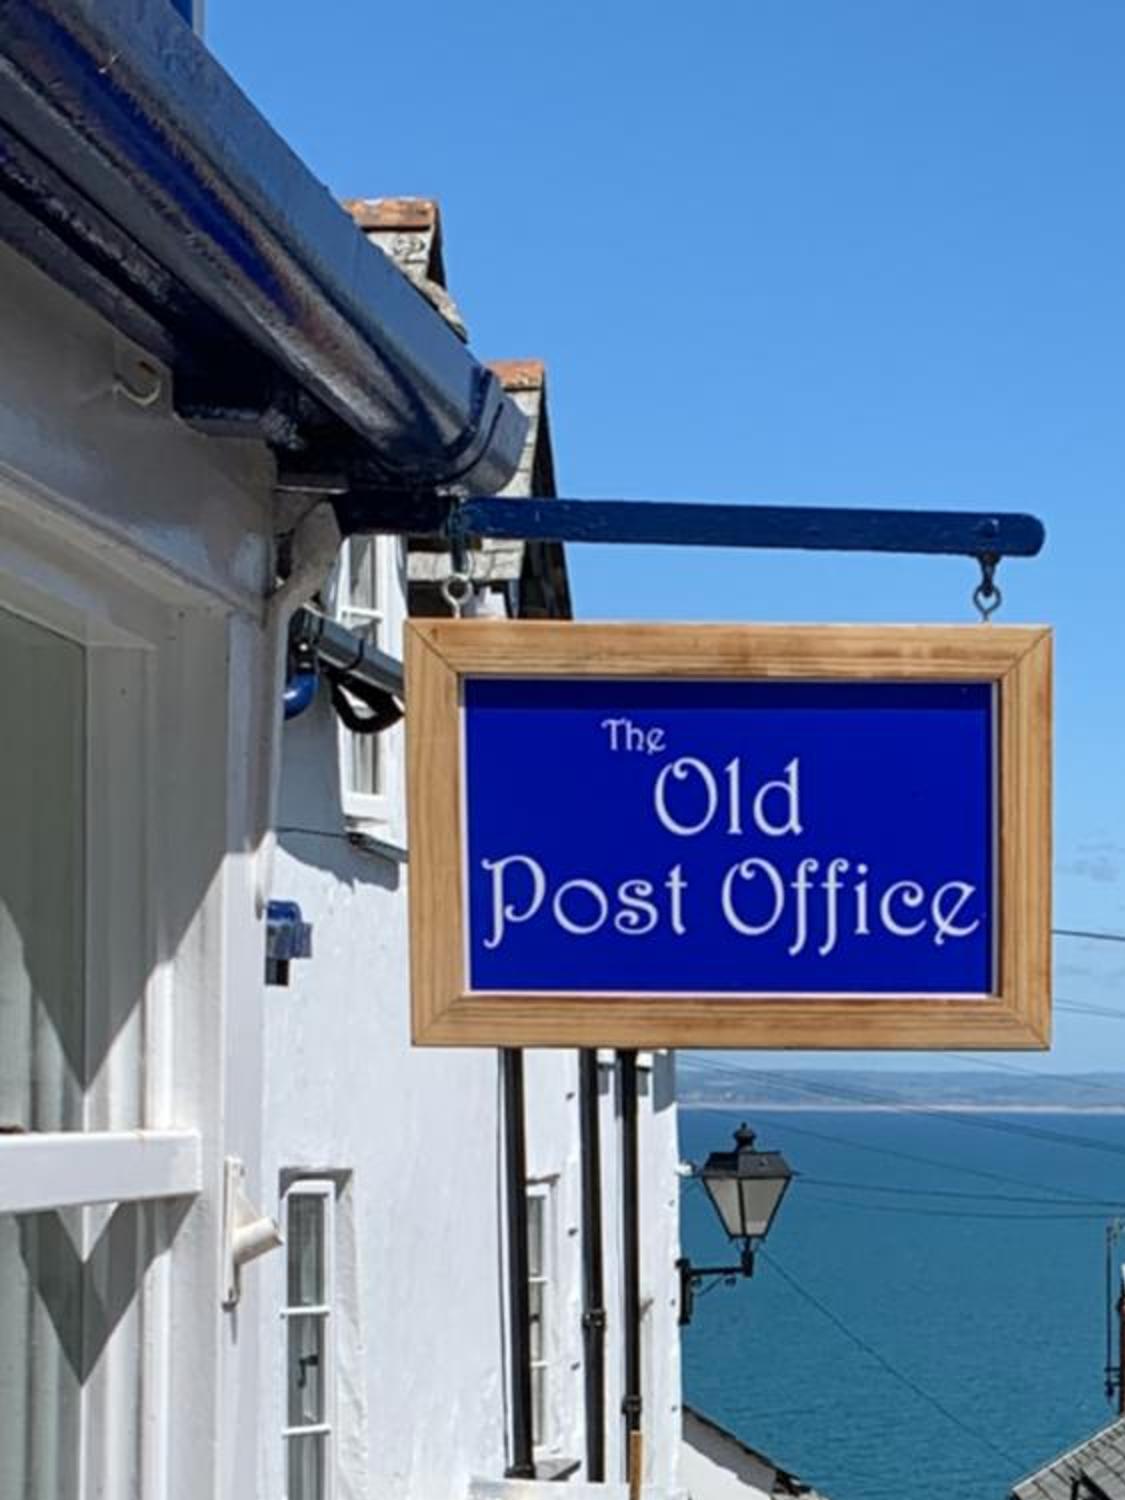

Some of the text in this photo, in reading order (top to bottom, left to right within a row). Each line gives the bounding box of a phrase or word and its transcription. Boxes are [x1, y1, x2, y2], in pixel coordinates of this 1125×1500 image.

[601, 717, 666, 754] The
[653, 756, 804, 838] Old
[481, 854, 982, 956] Post Office
